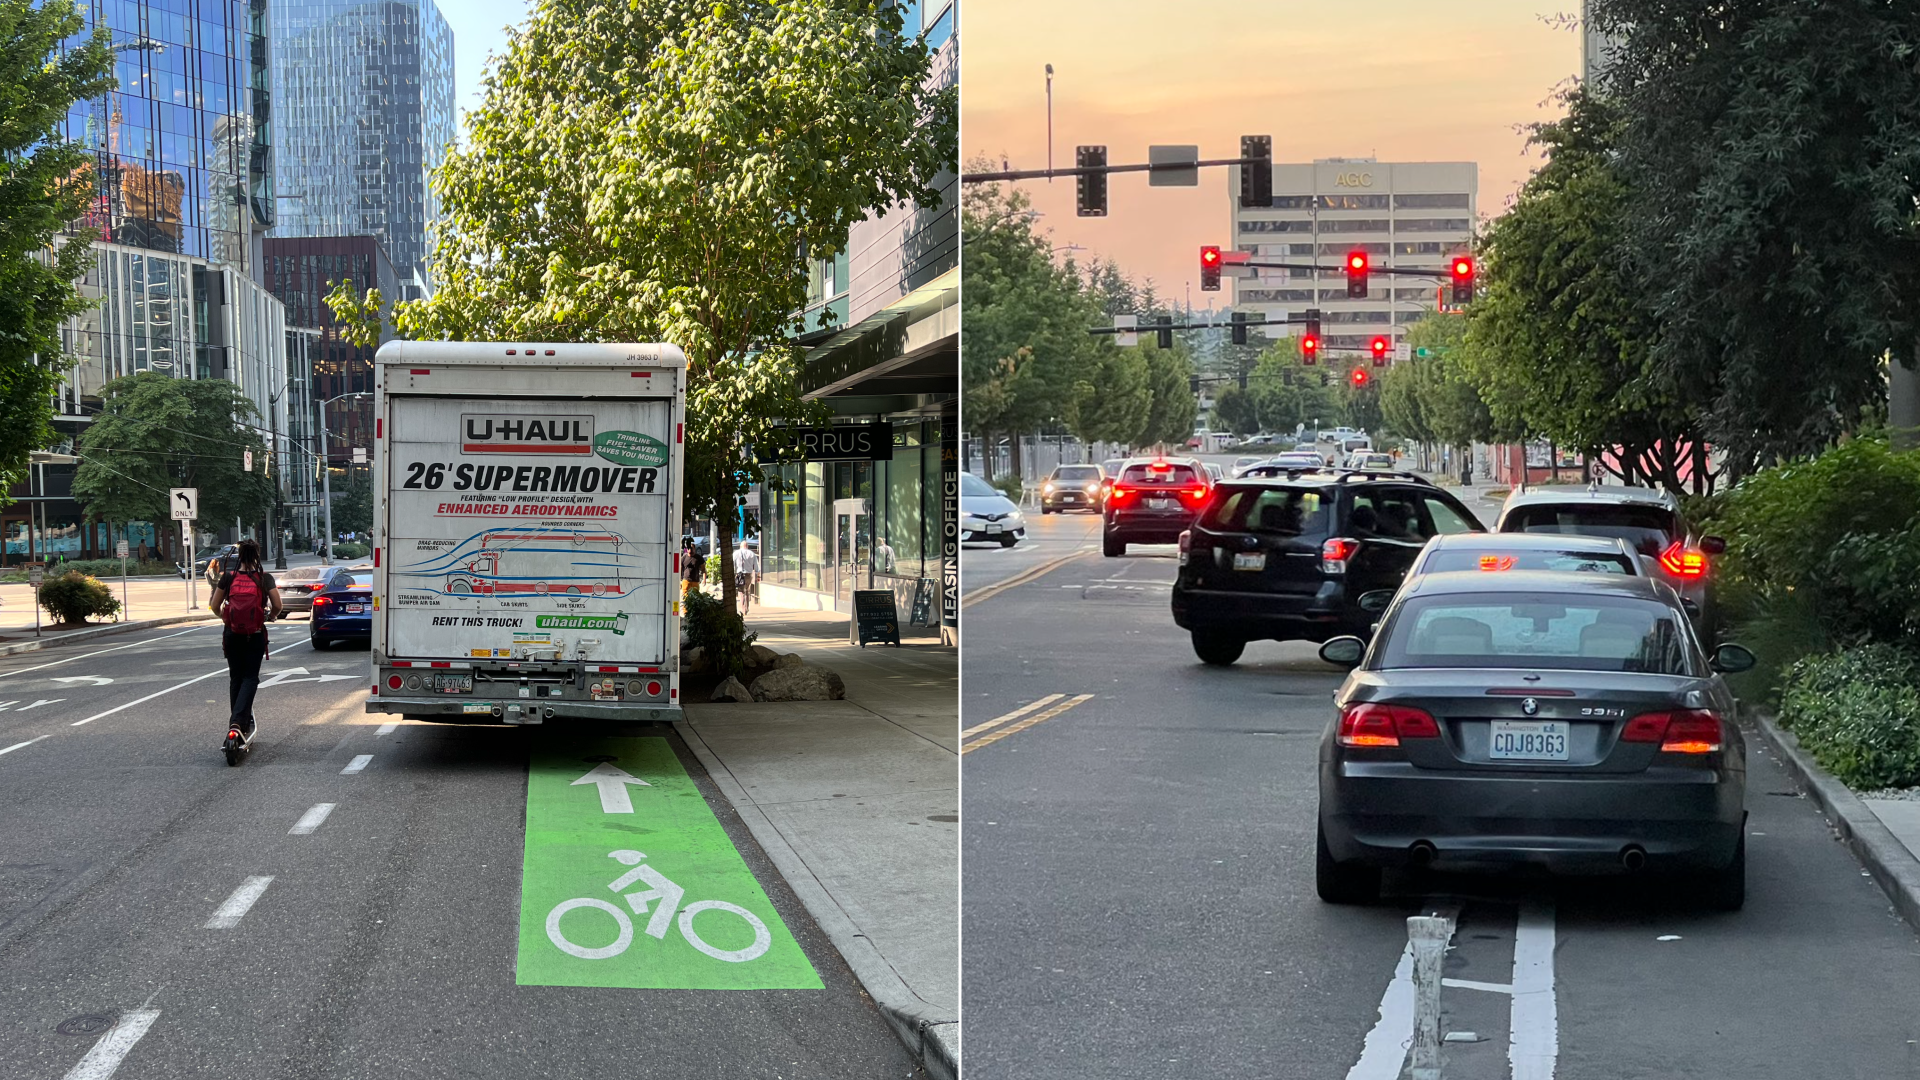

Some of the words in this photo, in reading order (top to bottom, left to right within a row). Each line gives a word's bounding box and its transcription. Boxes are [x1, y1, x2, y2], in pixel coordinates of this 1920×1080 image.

[1334, 172, 1373, 187] AGC
[467, 419, 588, 441] U-HAUL
[606, 439, 627, 449] FUEL
[630, 443, 658, 454] SAVER
[617, 433, 651, 445] TRIMLINE
[596, 446, 620, 456] SAVES
[621, 449, 636, 458] YOU
[637, 452, 664, 464] MONEY
[437, 503, 509, 514] ENHANCED
[511, 505, 618, 516] AERODYNAMICS
[944, 471, 957, 537] OFFICE
[944, 542, 957, 620] LEASING
[859, 596, 893, 604] CIRRUS
[432, 617, 460, 626] RENT
[461, 617, 484, 627] THIS
[486, 618, 523, 628] TRUCK!
[541, 617, 618, 629] uhaul.com
[1494, 733, 1565, 754] CDJ8363
